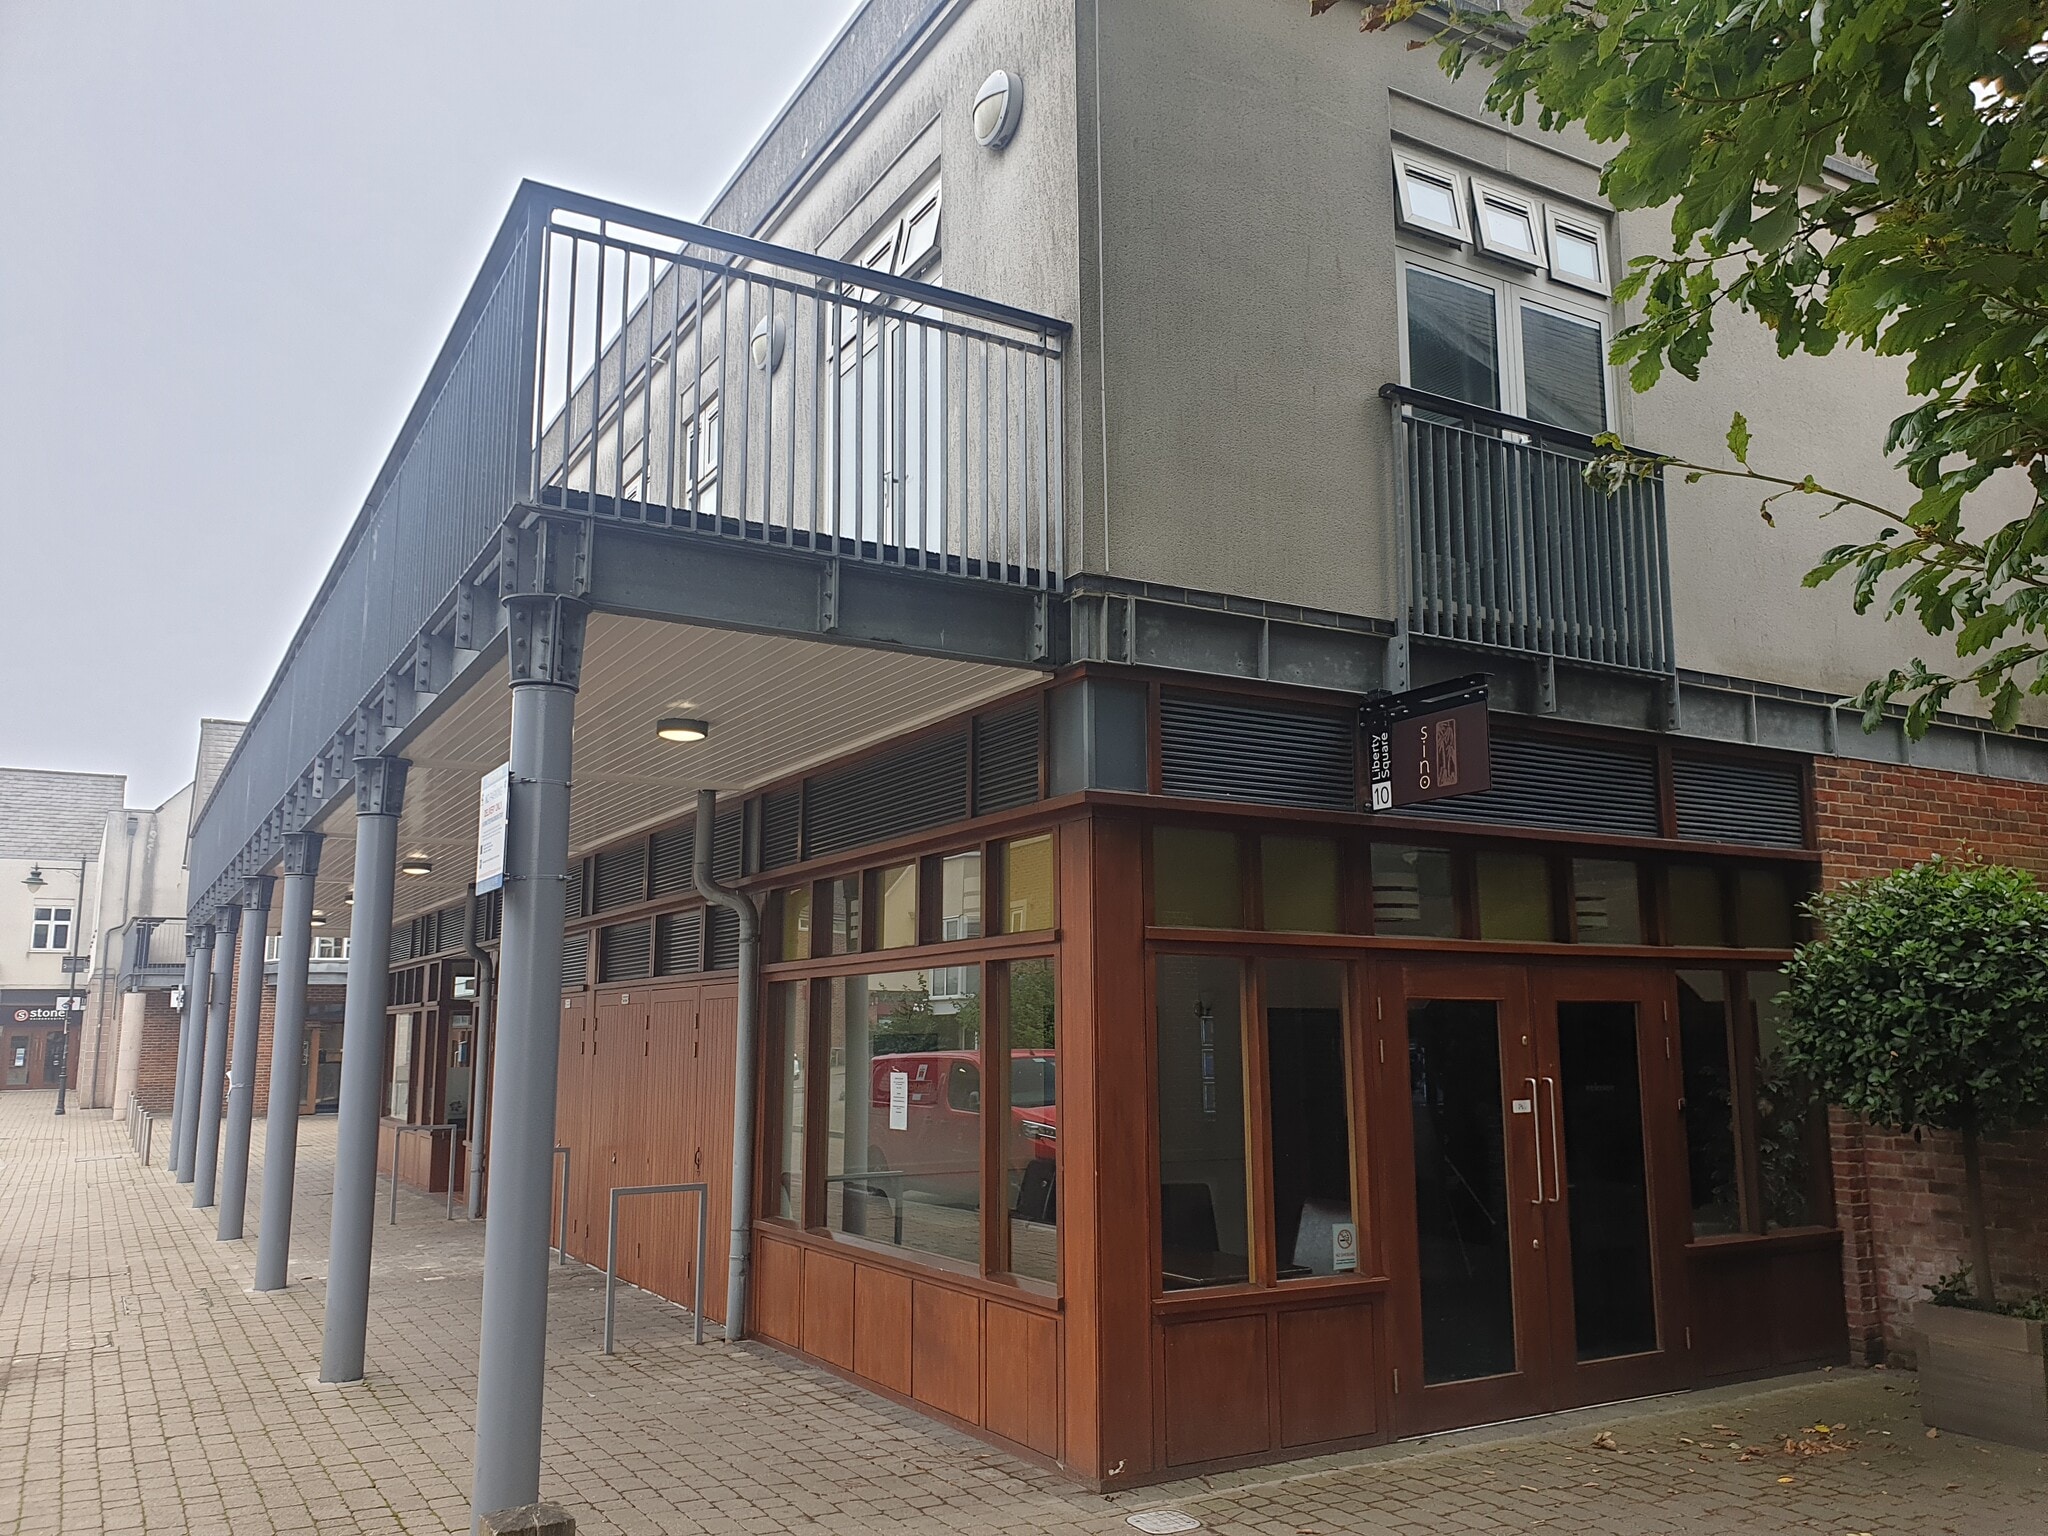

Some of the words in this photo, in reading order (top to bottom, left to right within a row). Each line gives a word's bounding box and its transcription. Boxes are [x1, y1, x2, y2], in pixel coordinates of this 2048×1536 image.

[1371, 734, 1381, 780] Liberty
[1381, 732, 1391, 778] Square
[1420, 726, 1430, 789] sino
[1374, 786, 1389, 805] 10
[30, 1009, 66, 1017] stone
